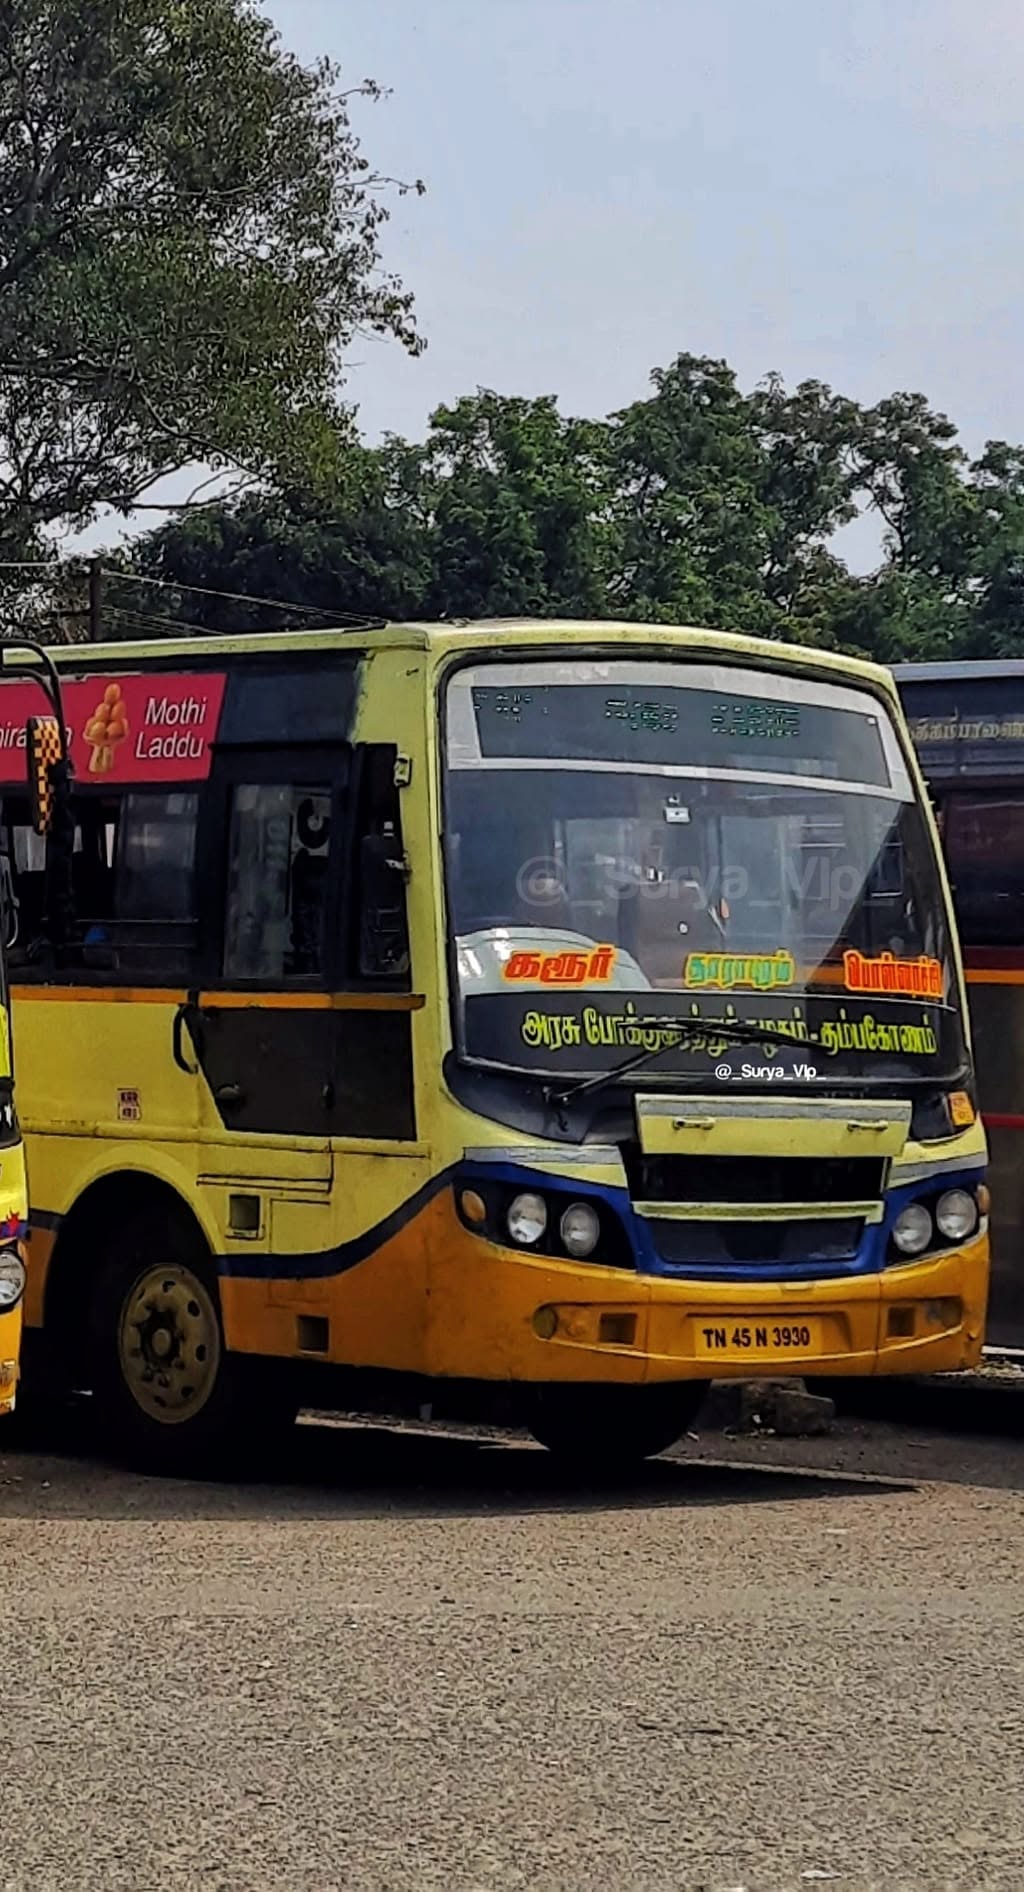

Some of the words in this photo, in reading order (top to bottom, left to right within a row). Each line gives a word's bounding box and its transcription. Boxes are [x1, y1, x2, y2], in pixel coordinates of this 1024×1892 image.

[144, 697, 207, 726] Mothi
[135, 730, 204, 759] Laddu
[503, 944, 616, 986] கரூர்
[522, 1011, 580, 1051] அரசு
[702, 1328, 727, 1349] TN
[731, 1328, 752, 1348] 45
[755, 1327, 768, 1347] N
[772, 1326, 811, 1347] 3930
